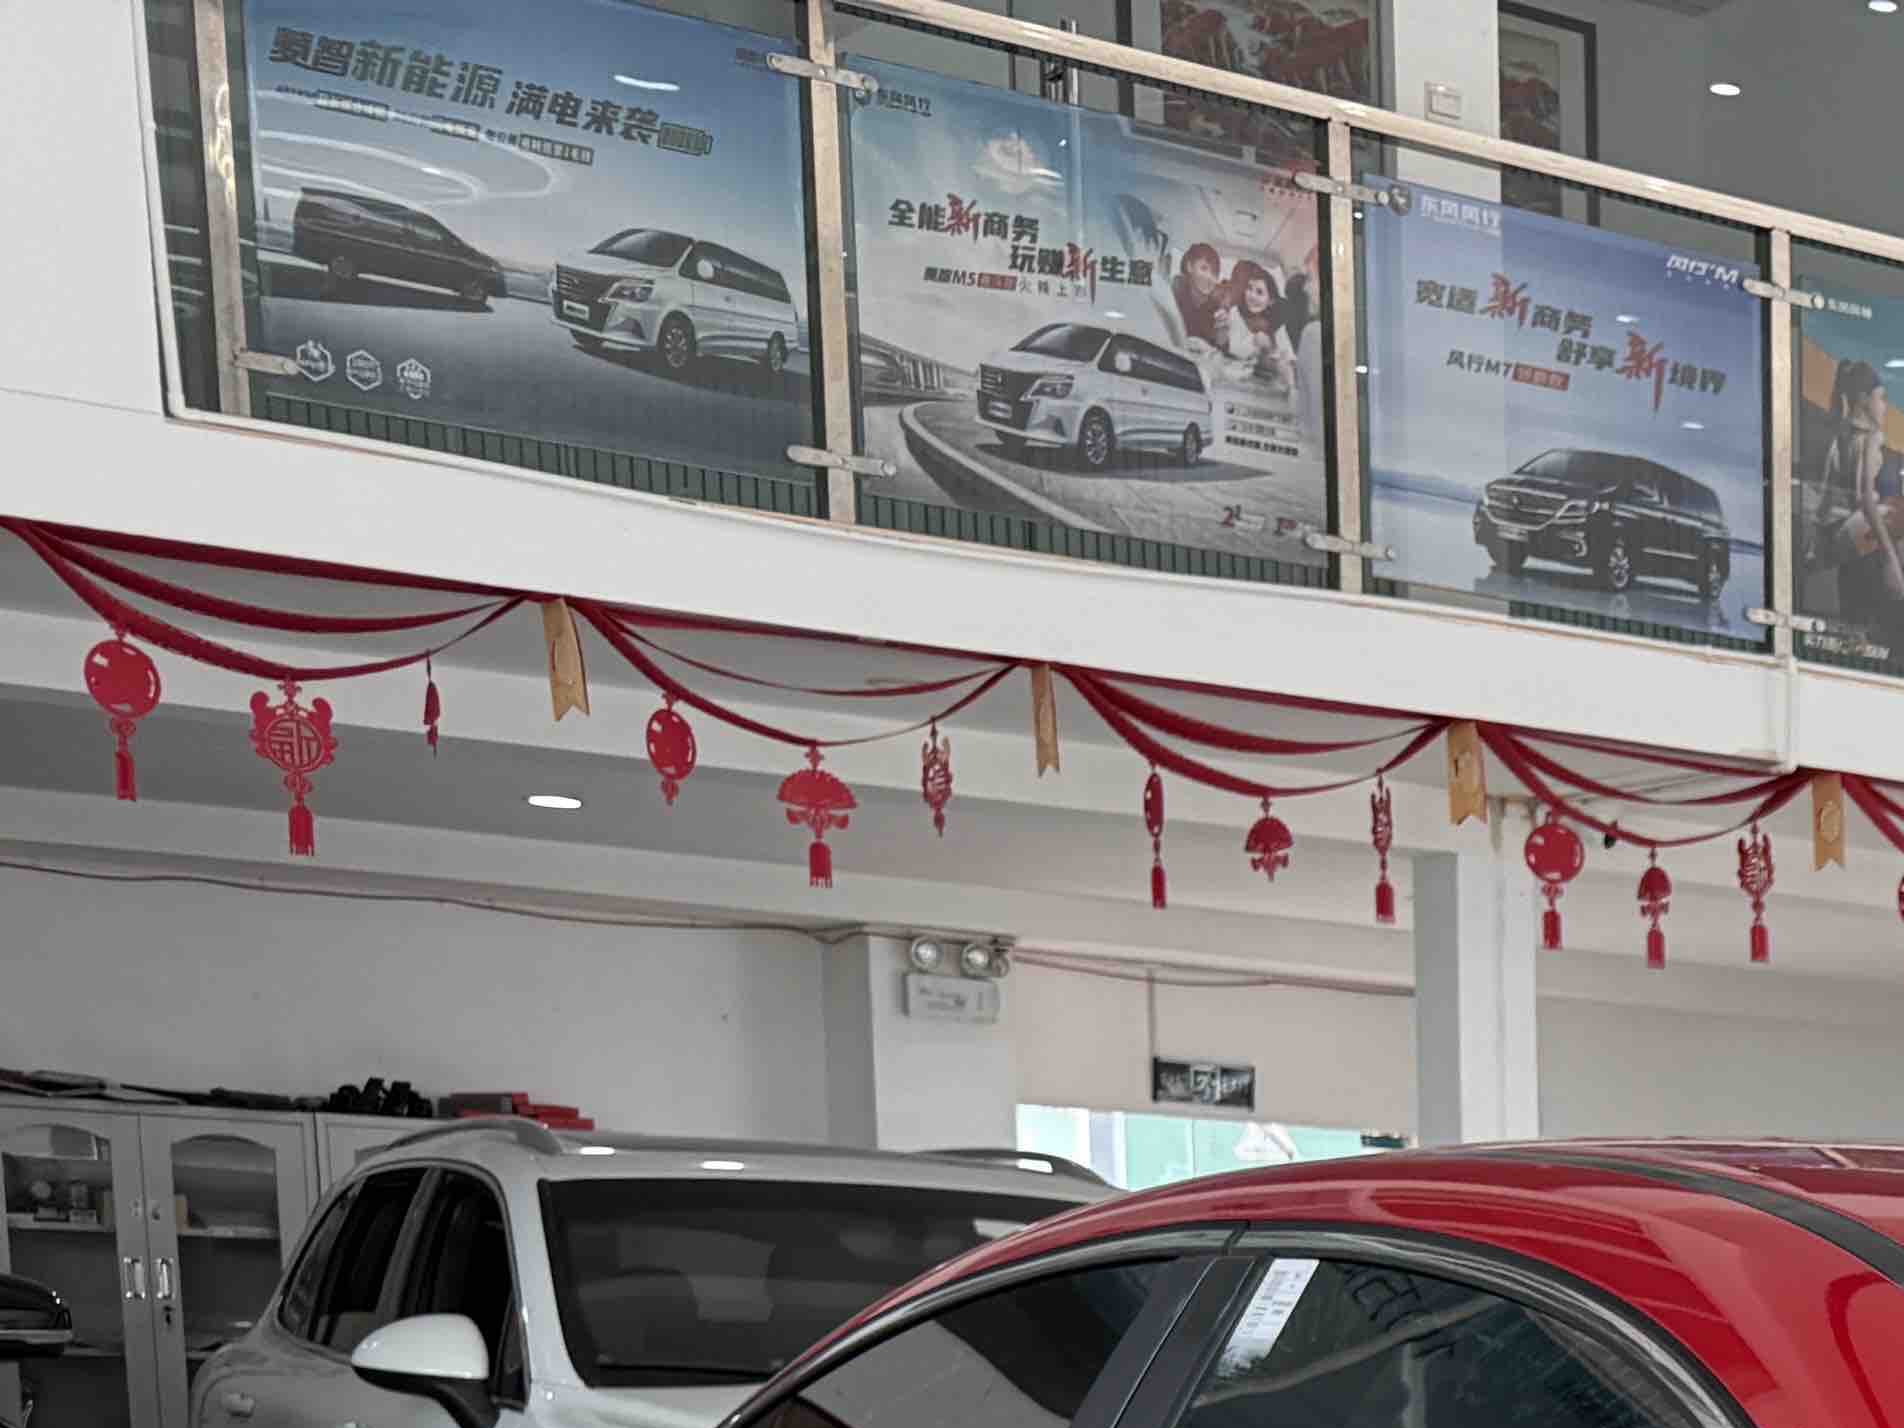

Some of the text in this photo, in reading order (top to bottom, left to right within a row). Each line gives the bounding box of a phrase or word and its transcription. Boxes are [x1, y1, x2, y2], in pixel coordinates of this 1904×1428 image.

[888, 193, 1040, 244] 全能新商务
